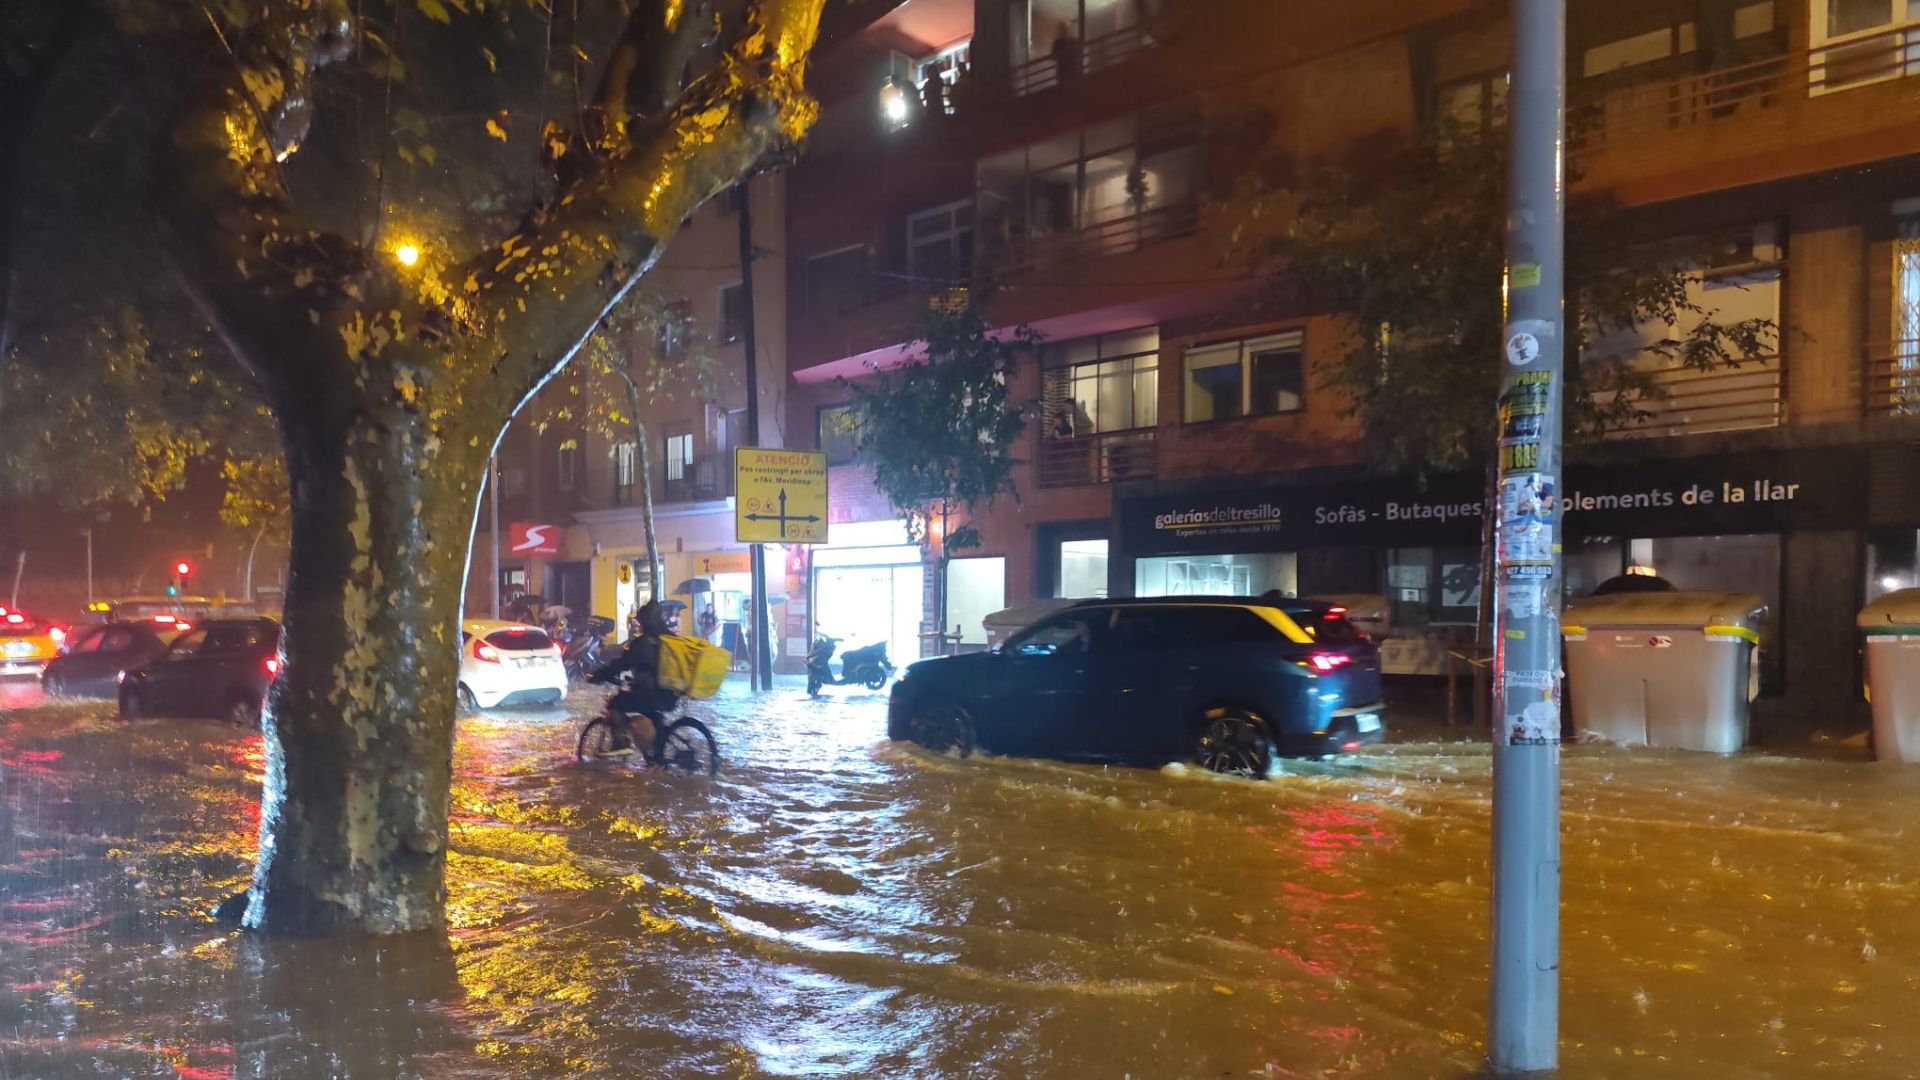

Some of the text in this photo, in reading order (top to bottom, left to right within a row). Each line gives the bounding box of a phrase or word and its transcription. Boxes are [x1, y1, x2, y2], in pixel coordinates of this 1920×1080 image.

[1561, 479, 1801, 512] plements de la llar
[1315, 505, 1367, 525] Sofàs
[1385, 502, 1482, 523] Butaques
